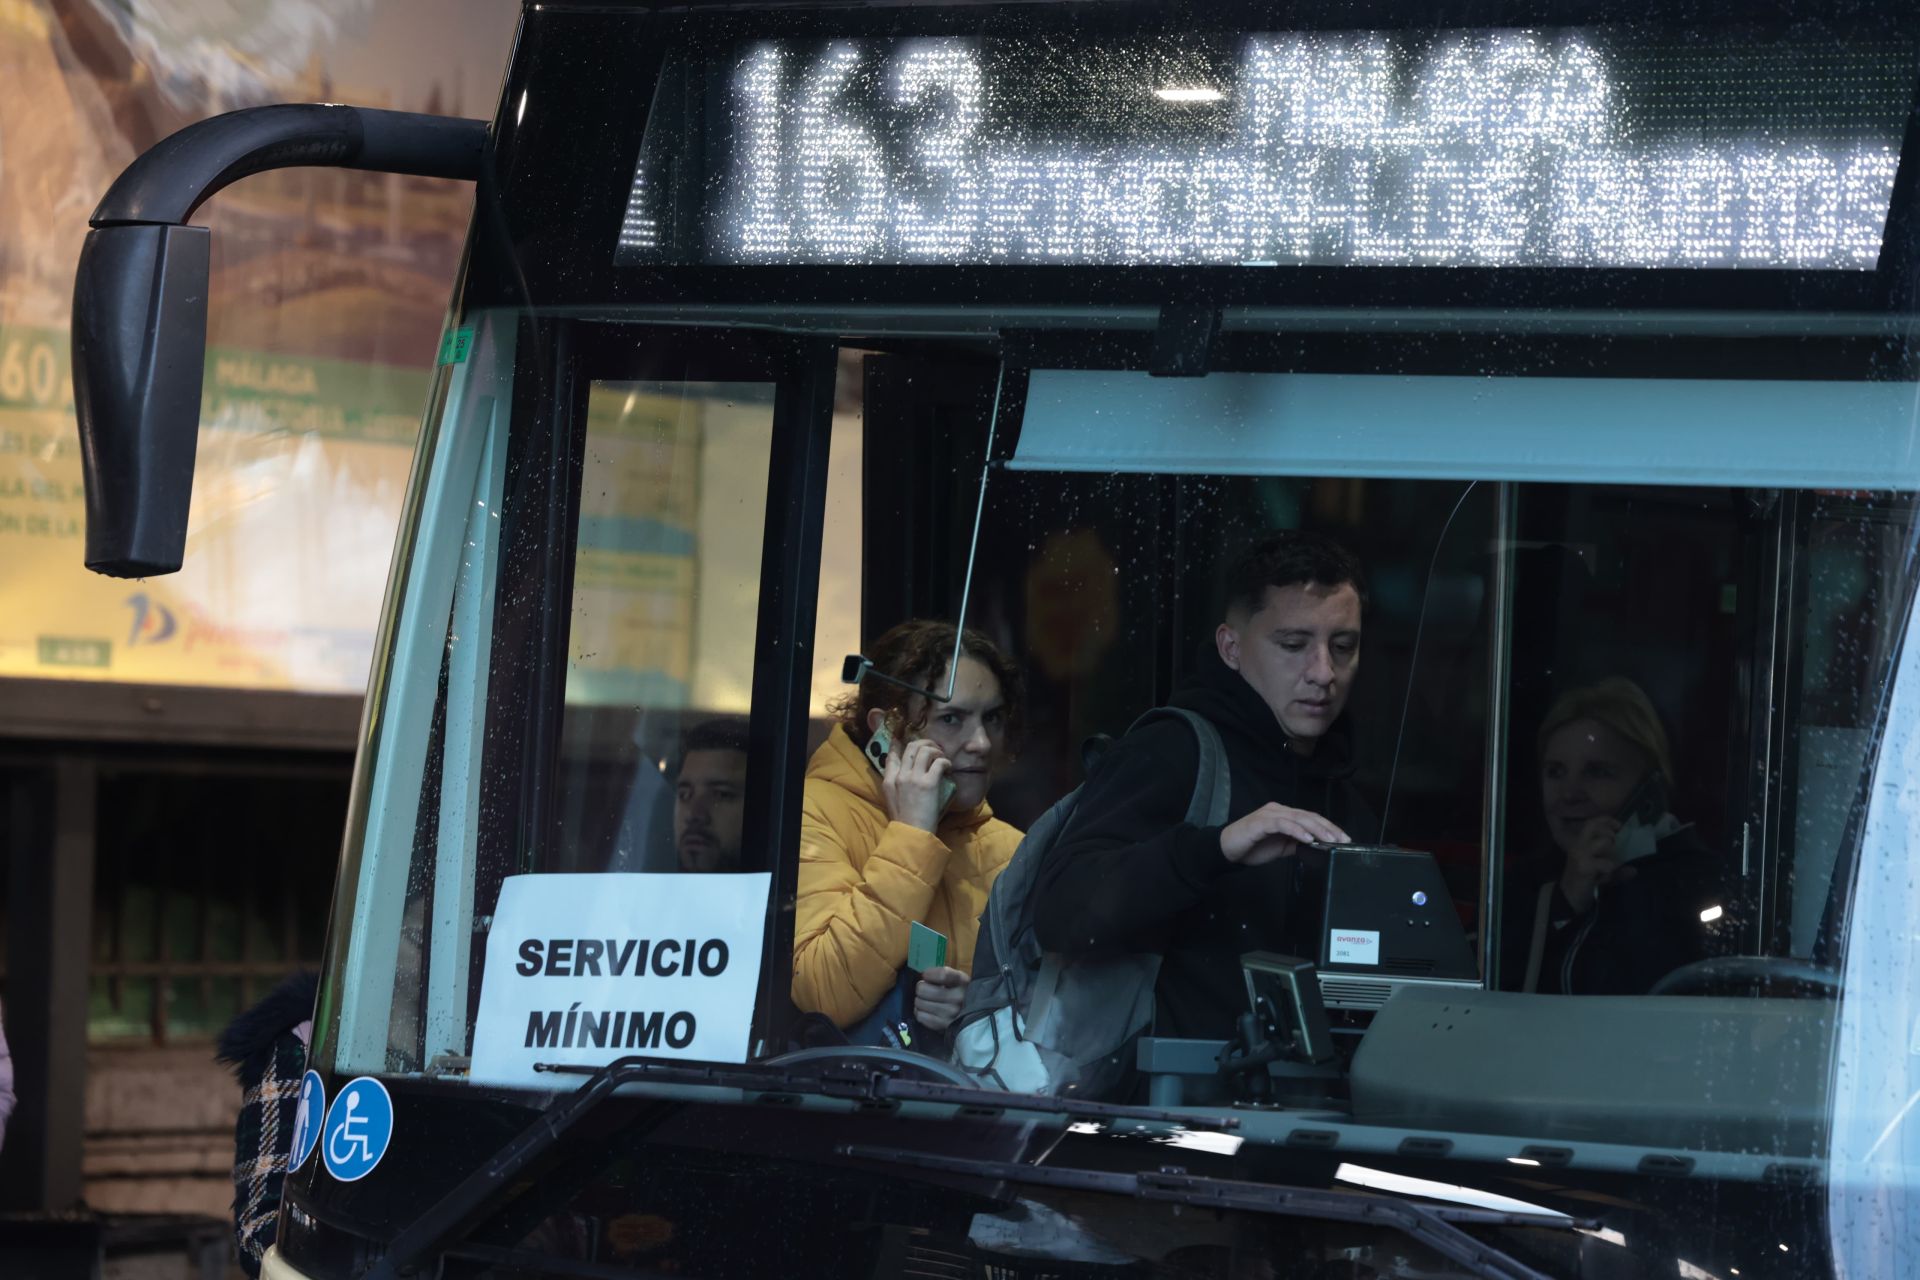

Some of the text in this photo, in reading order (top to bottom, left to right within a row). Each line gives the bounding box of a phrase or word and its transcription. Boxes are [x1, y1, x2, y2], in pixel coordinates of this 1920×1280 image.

[733, 46, 986, 258] 163
[515, 938, 729, 977] SERVICIO
[524, 1001, 697, 1050] MÍNIMO
